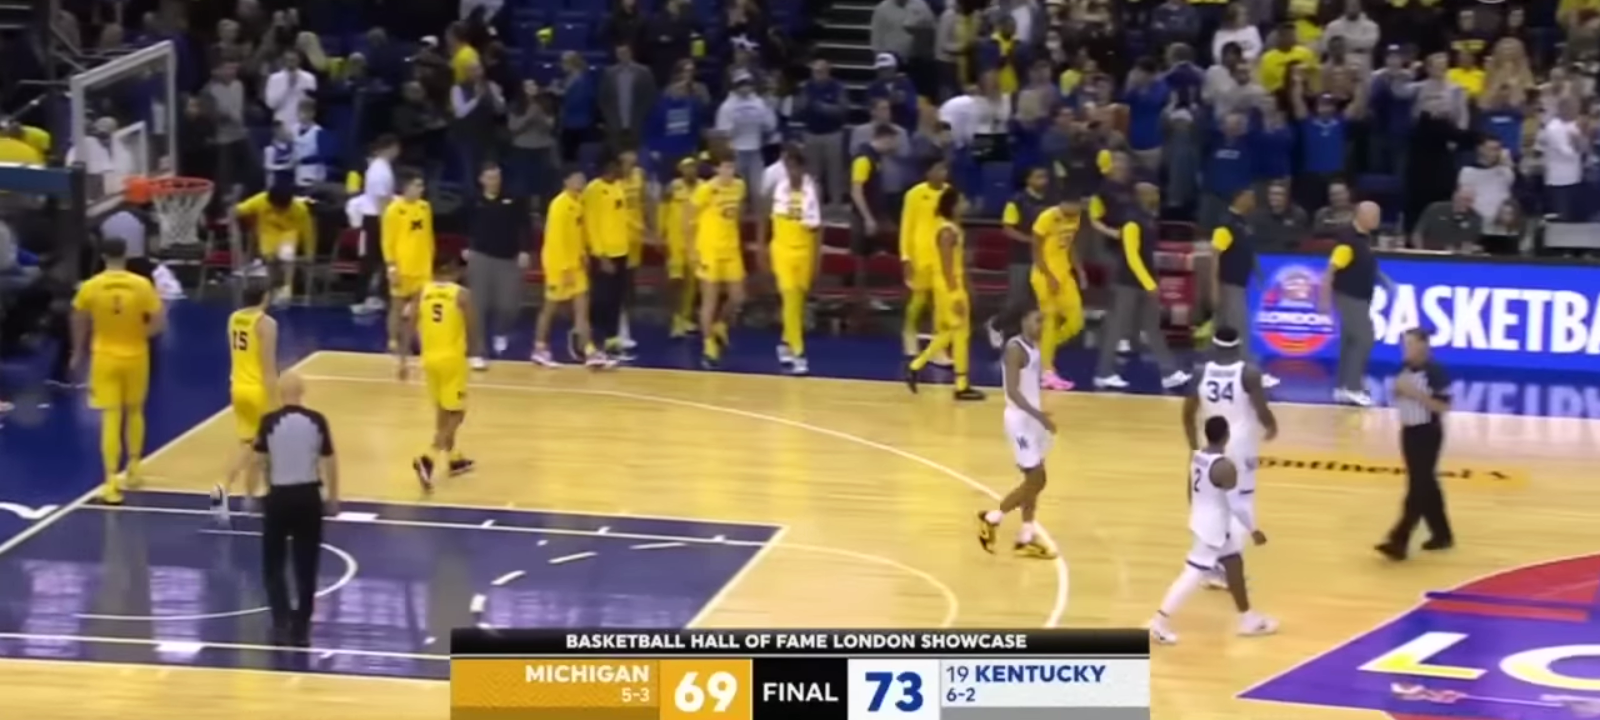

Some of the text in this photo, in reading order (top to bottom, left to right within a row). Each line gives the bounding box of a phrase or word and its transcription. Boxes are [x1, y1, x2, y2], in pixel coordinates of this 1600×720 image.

[432, 303, 443, 323] 5
[233, 330, 248, 351] 15
[1206, 380, 1234, 403] 34
